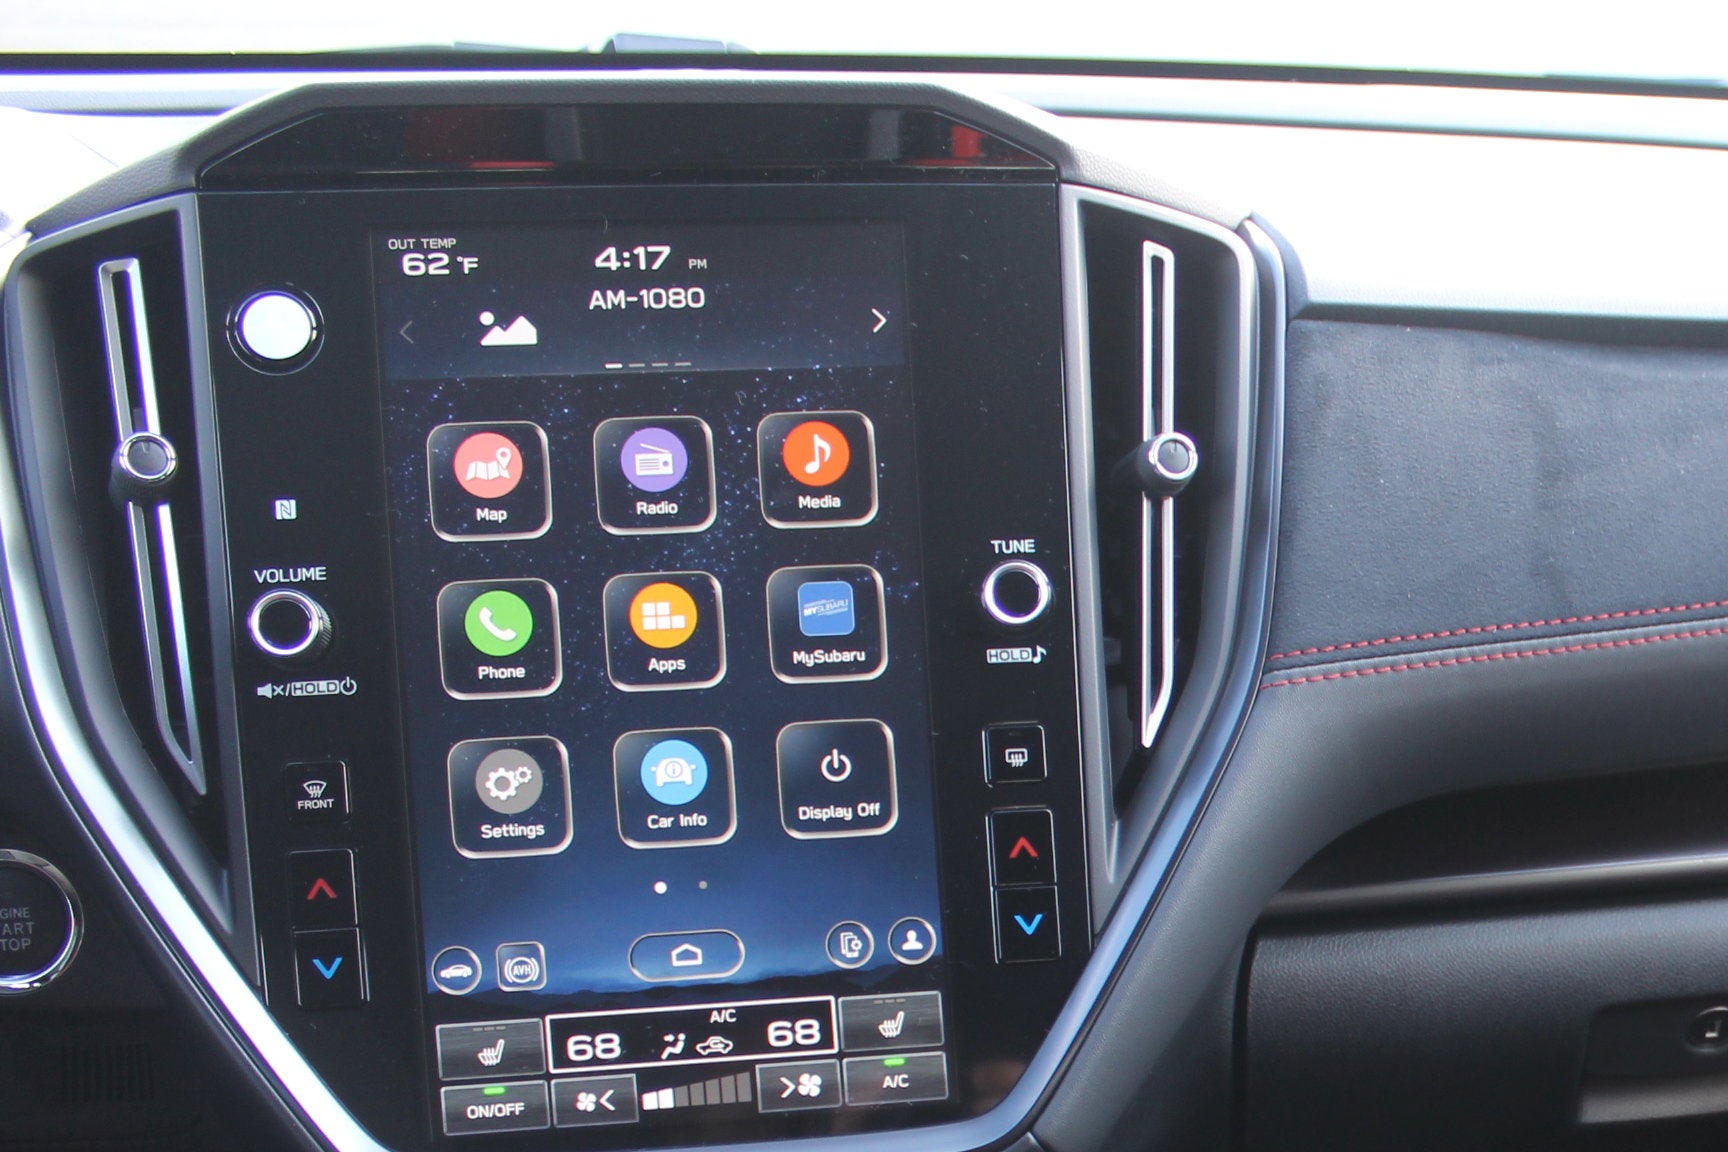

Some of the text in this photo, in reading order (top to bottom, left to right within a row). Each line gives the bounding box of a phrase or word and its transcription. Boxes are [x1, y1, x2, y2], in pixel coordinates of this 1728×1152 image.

[388, 237, 456, 250] OUT TEMP
[402, 253, 450, 276] 62
[594, 245, 707, 270] 4:17 PM
[589, 287, 705, 310] AM-1080
[636, 500, 678, 515] Radio
[798, 494, 840, 510] Media
[476, 507, 507, 524] Map
[990, 539, 1036, 554] TUNE
[254, 567, 327, 583] VOLUME
[793, 649, 865, 667] MySubaru
[987, 648, 1032, 663] HOLD
[478, 664, 526, 680] Phone
[648, 656, 686, 674] Apps
[297, 799, 334, 810] FRONT
[798, 802, 881, 822] Display Off
[647, 812, 707, 829] Car Info
[481, 822, 545, 840] Settings
[0, 907, 31, 919] GINE
[2, 921, 35, 936] ART
[0, 938, 31, 951] TOP
[513, 964, 531, 976] AVH
[709, 1008, 737, 1024] A/C
[767, 1018, 821, 1048] 68
[566, 1033, 621, 1062] 68
[882, 1073, 909, 1090] A/C
[467, 1102, 525, 1119] ON/OFF
